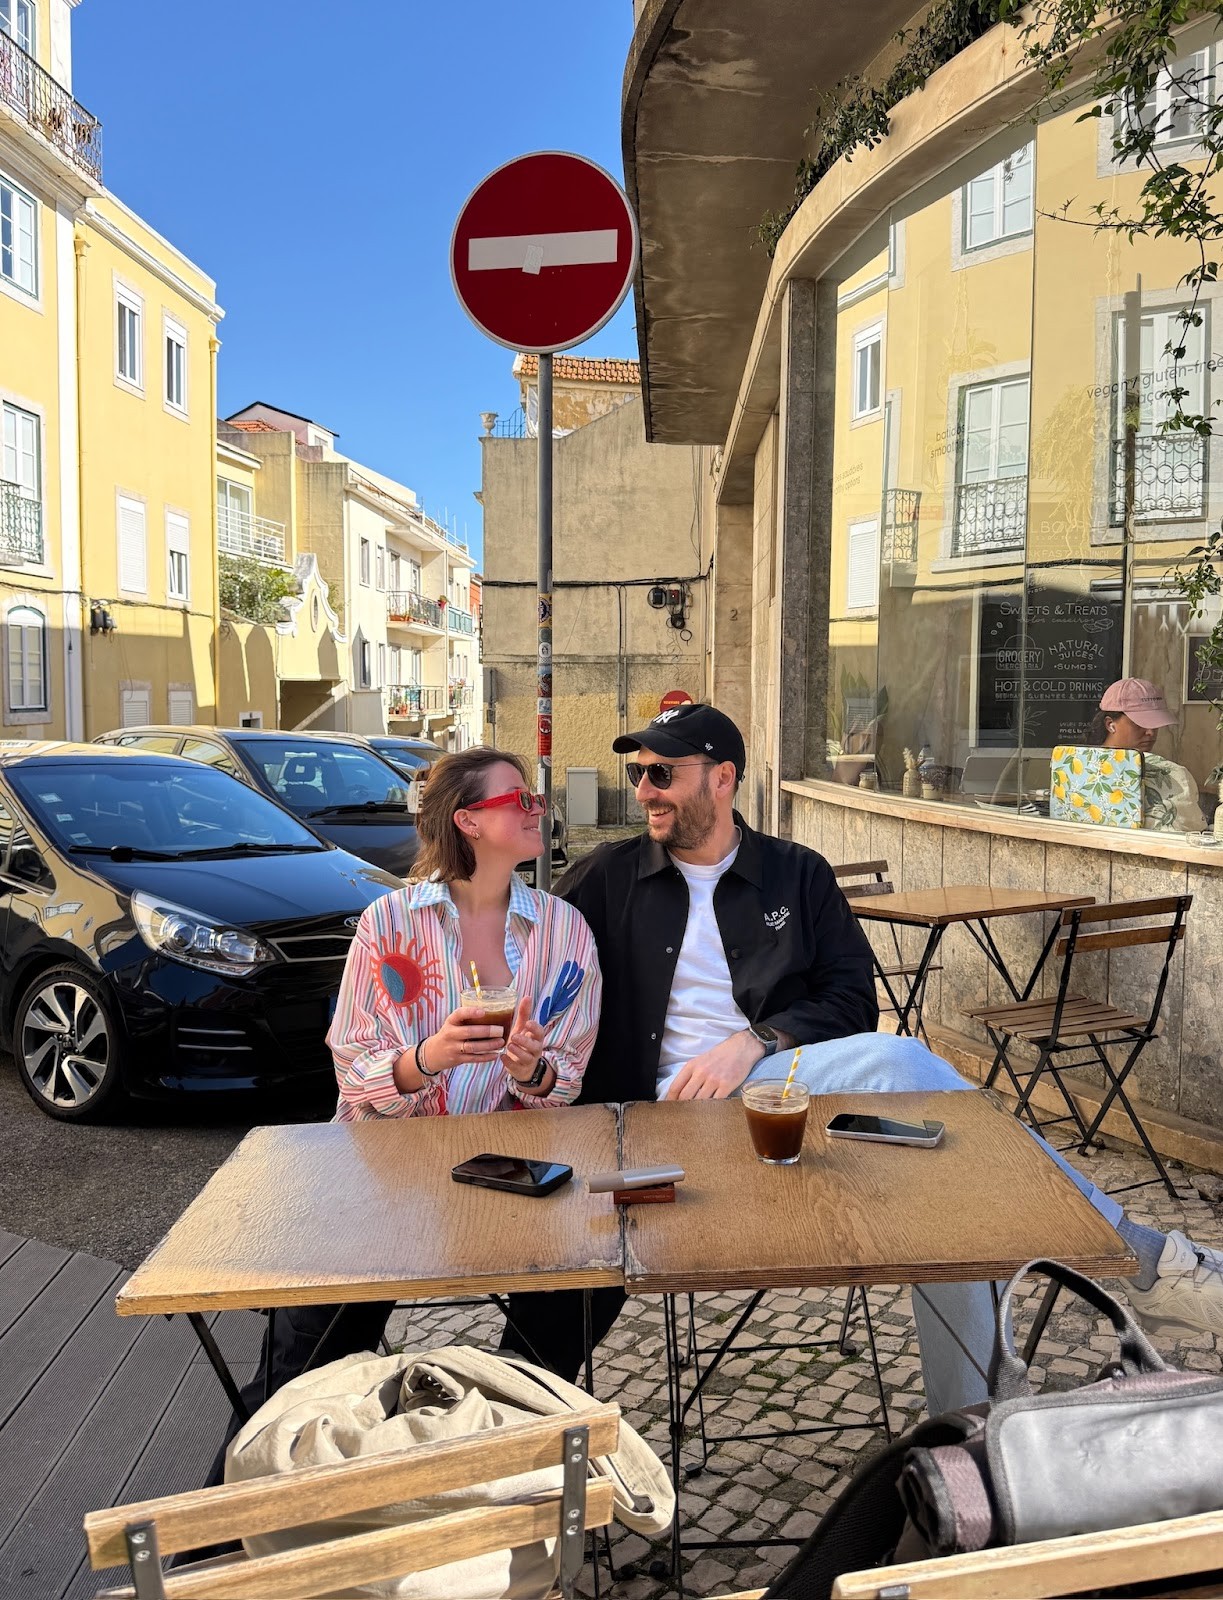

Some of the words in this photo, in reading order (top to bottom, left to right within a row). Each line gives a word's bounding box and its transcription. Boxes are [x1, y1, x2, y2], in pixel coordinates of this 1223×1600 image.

[1086, 380, 1128, 399] vegan
[1142, 359, 1223, 389] gluten-free
[936, 424, 965, 442] batidos
[730, 608, 738, 622] 2
[1054, 605, 1065, 616] &
[1065, 602, 1108, 616] TREATS
[1048, 639, 1105, 658] NATURAL
[1058, 650, 1094, 660] JUICES
[998, 649, 1041, 663] GROCERY
[1056, 663, 1094, 671] SUMOS
[994, 681, 1020, 692] HOT
[1023, 681, 1031, 692] &
[1032, 681, 1067, 692] COLD
[1069, 681, 1104, 692] DRINKS
[764, 905, 789, 921] A.P.C.
